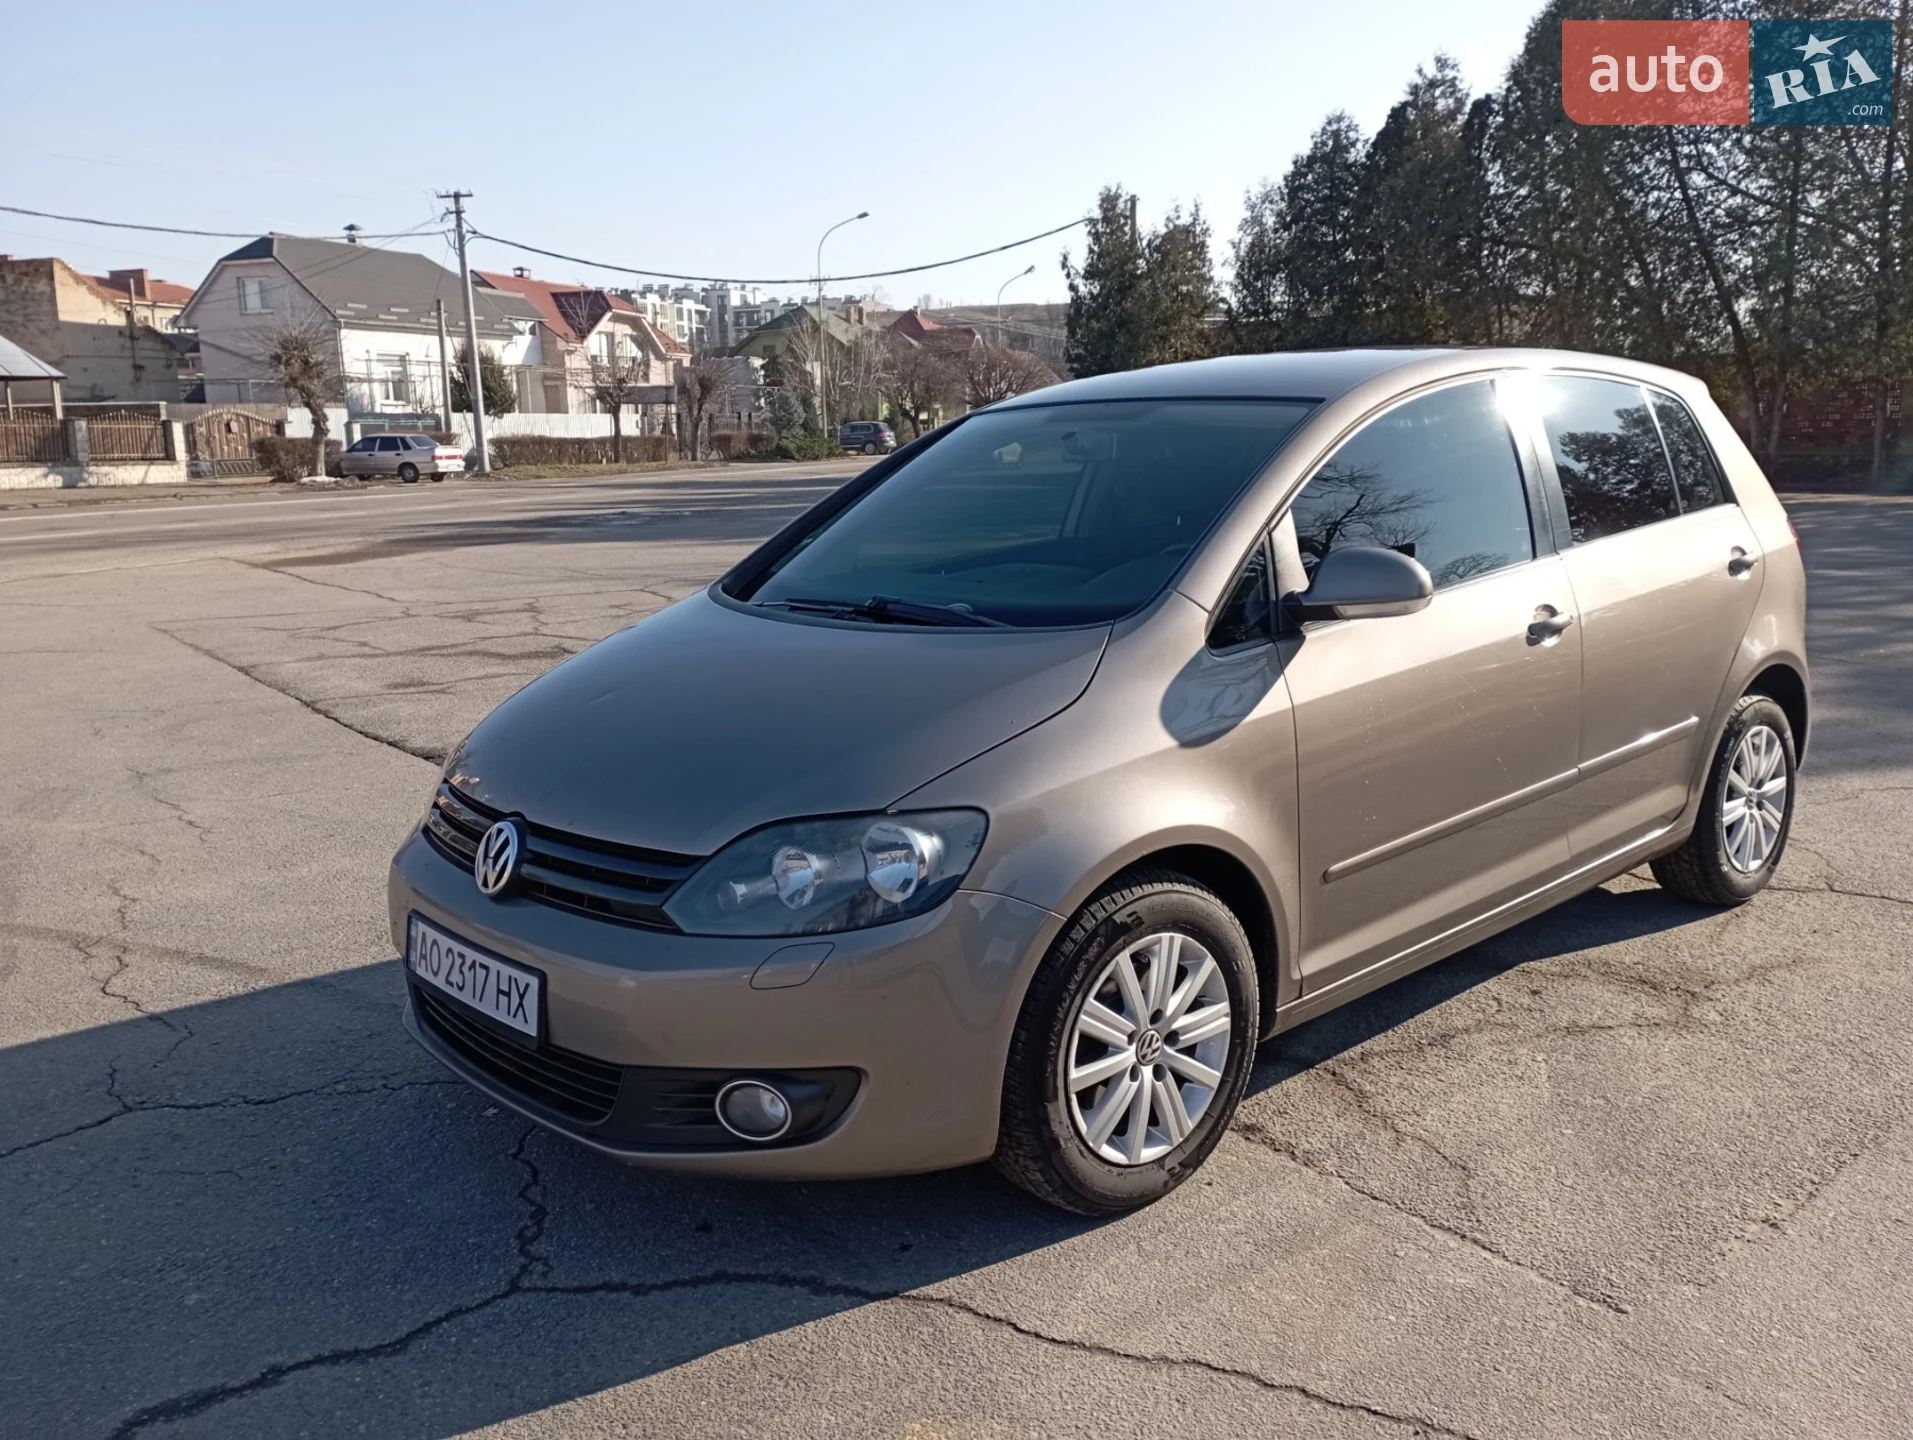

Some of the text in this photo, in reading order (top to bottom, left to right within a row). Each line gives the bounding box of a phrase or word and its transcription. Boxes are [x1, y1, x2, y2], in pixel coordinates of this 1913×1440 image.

[418, 931, 441, 978] AO
[444, 947, 491, 1003] 2317
[495, 969, 531, 1025] HX
